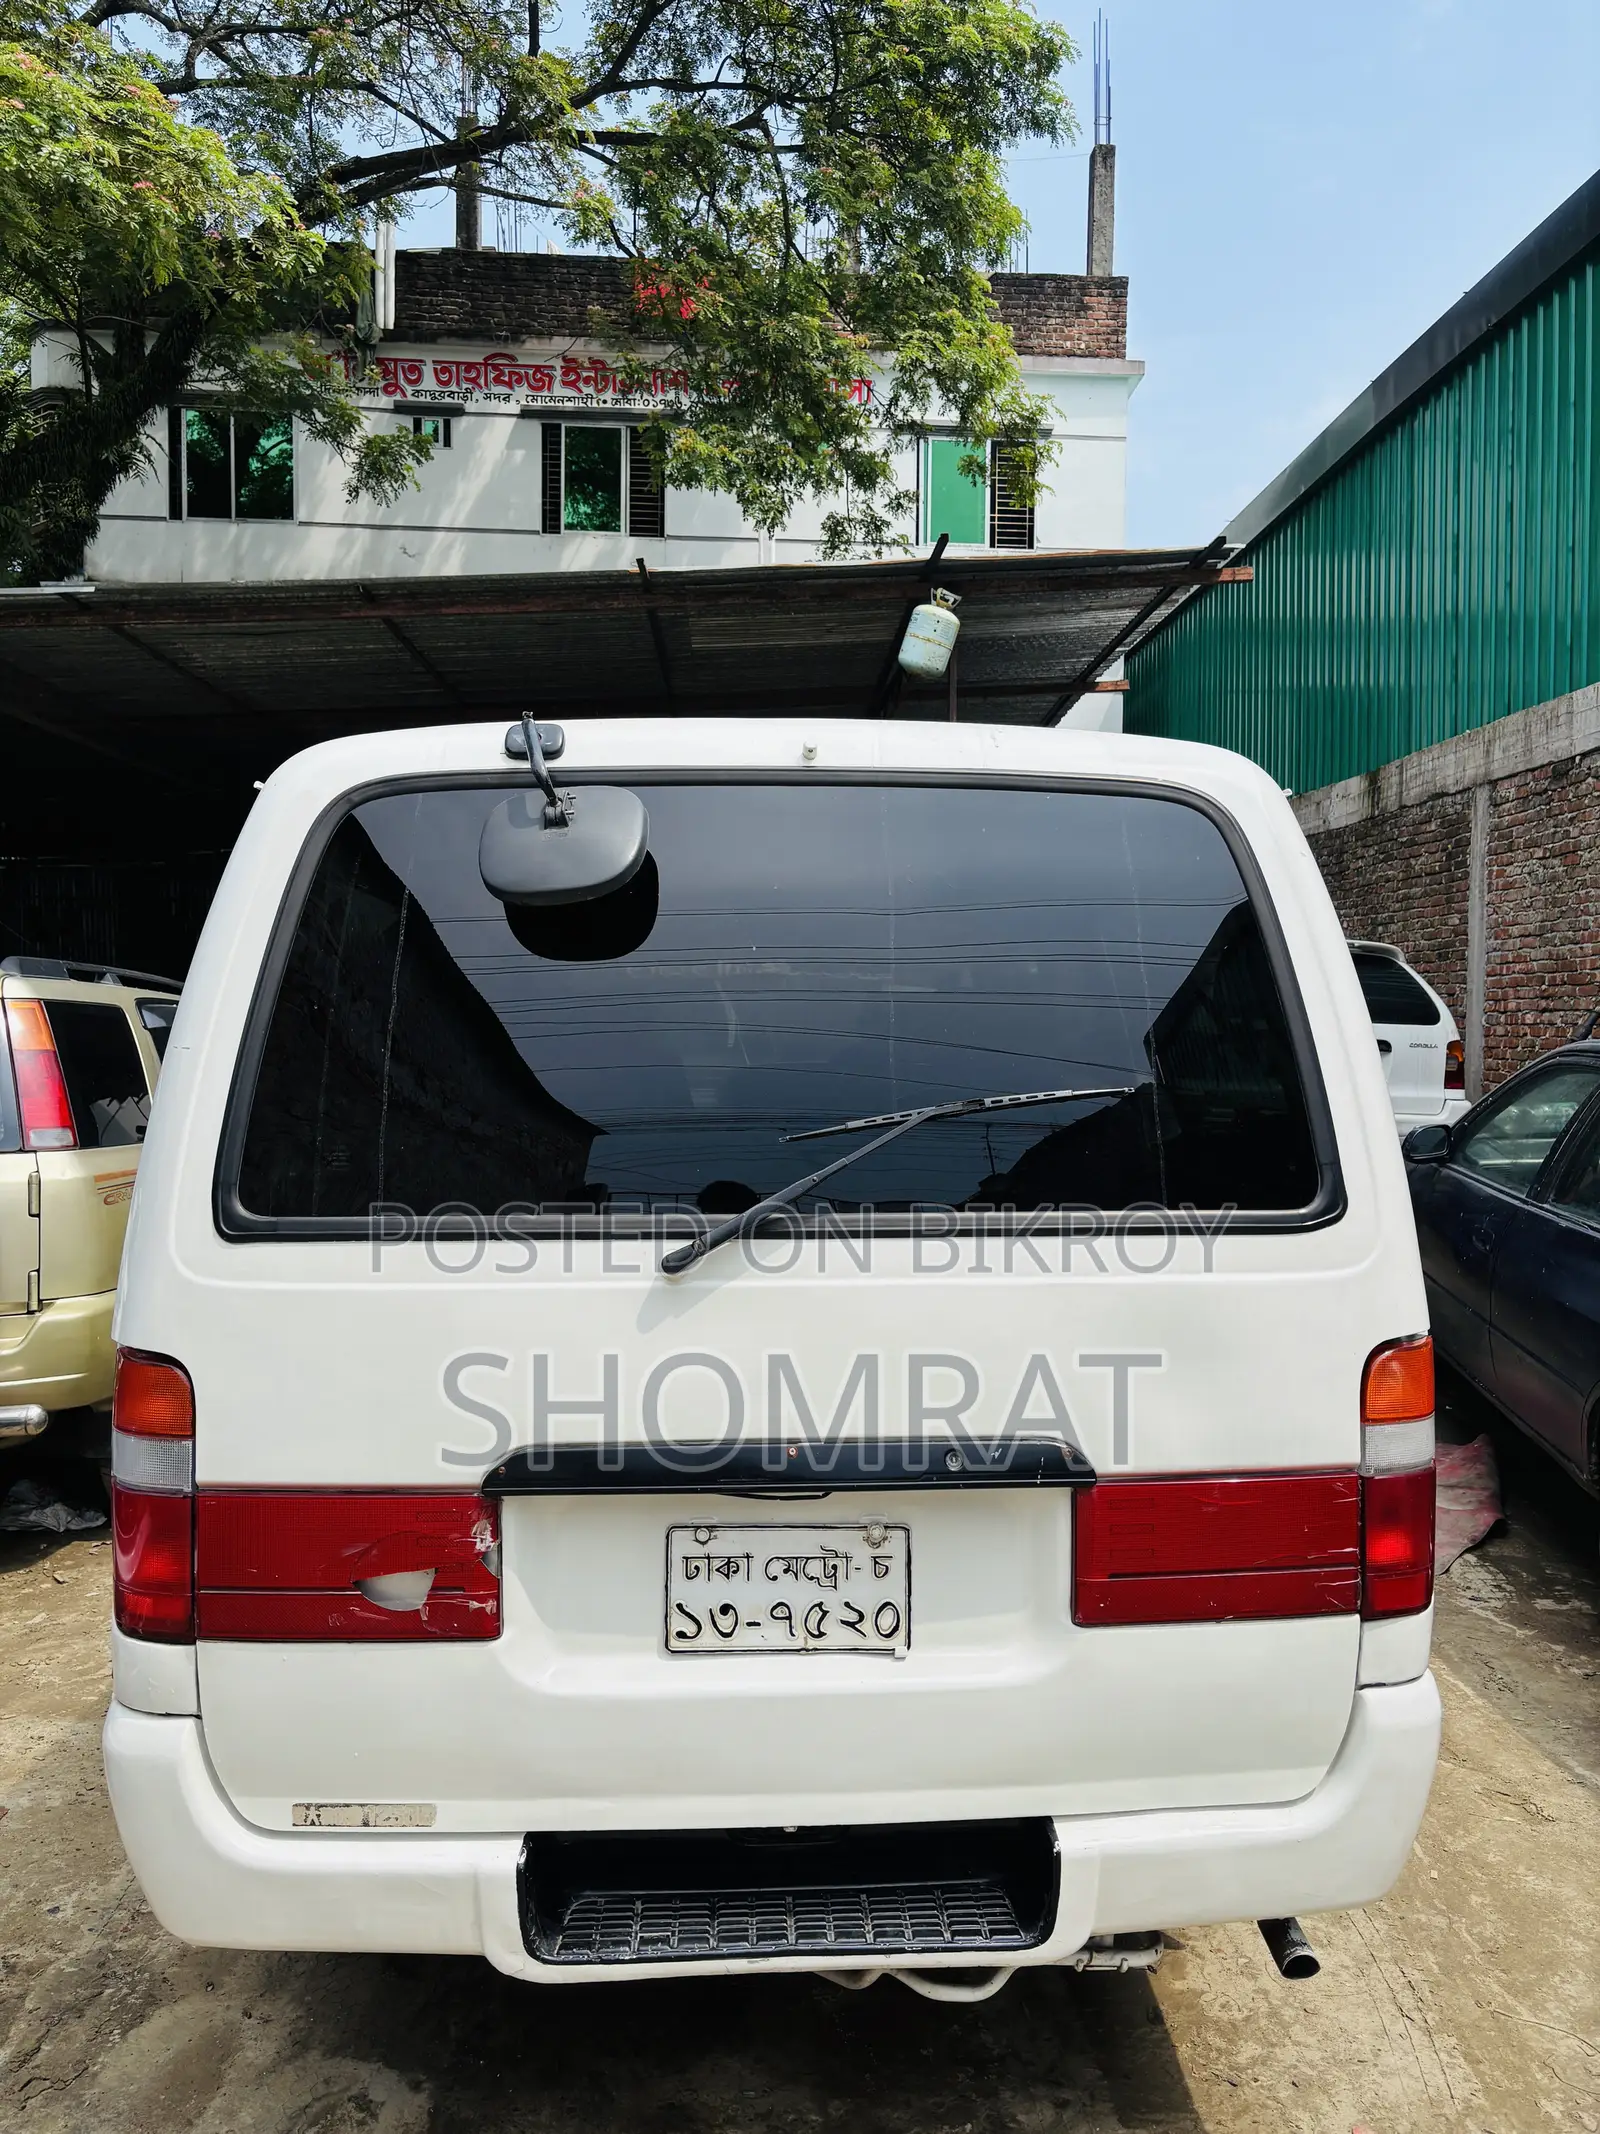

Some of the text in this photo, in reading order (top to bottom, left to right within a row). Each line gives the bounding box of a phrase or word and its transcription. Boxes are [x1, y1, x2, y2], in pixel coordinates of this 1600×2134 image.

[682, 1552, 754, 1582] ঢাকা
[871, 1556, 893, 1579] চ
[671, 1601, 900, 1639] ১৩-৭৫২০
